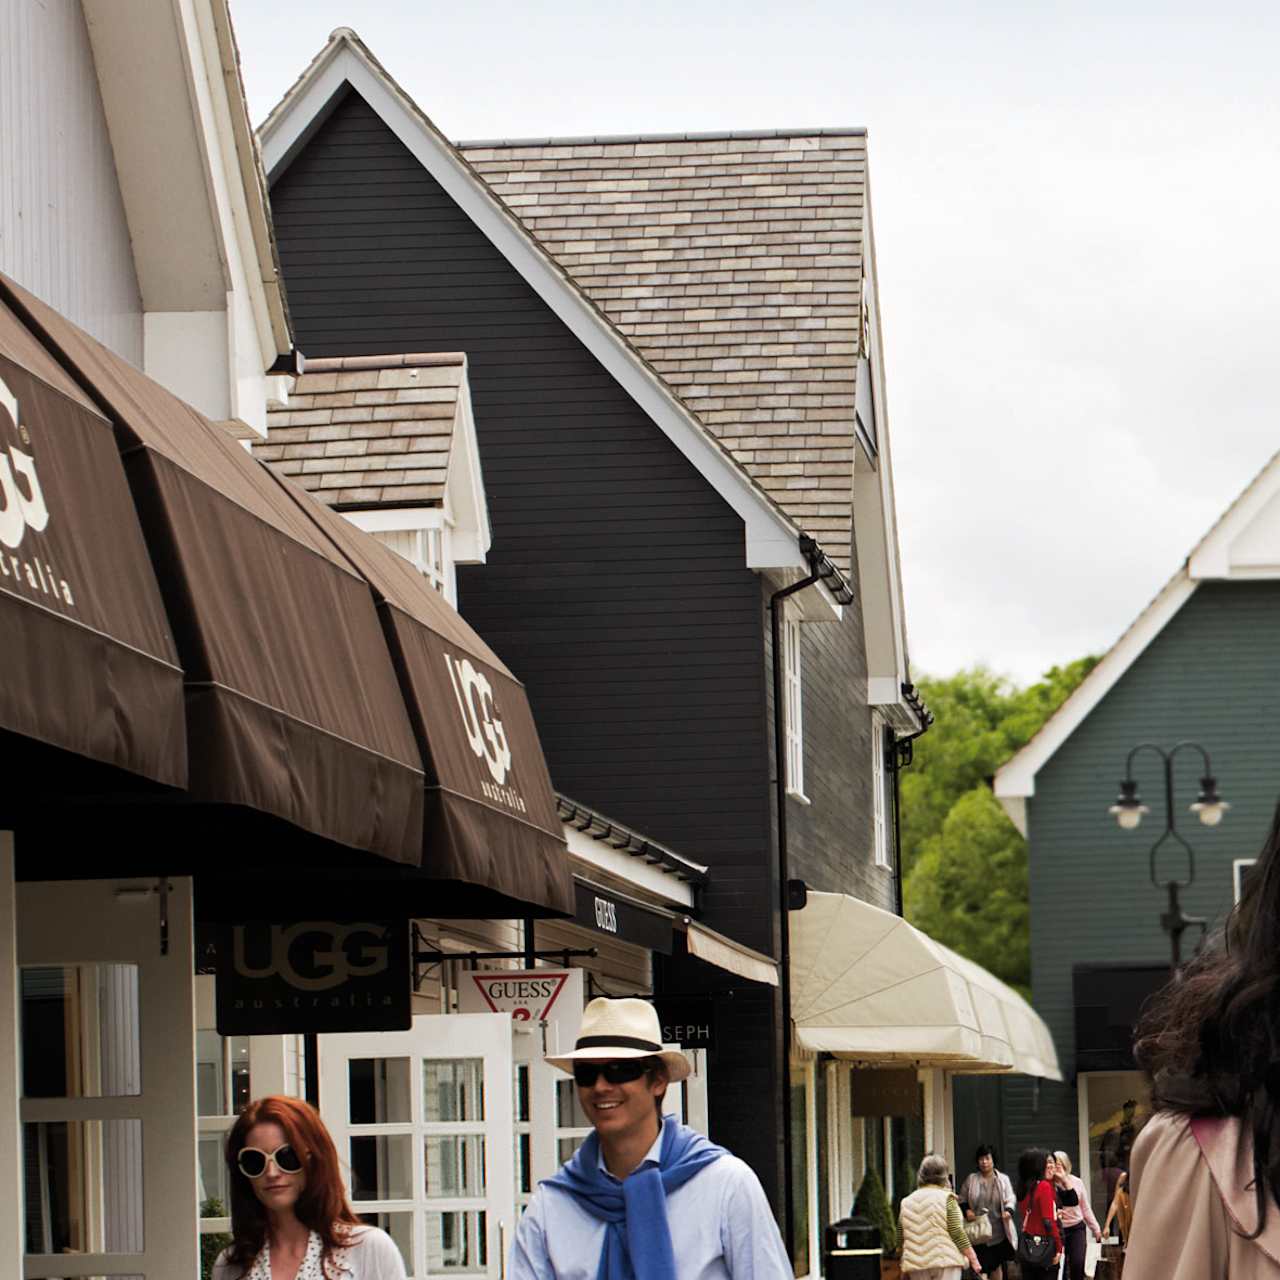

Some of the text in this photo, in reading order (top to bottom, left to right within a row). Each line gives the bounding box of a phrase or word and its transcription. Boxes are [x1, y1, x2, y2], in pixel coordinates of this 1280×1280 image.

[443, 653, 512, 786] UGG
[594, 896, 617, 934] GUESS
[232, 920, 390, 992] UGG
[233, 993, 393, 1009] australia
[488, 981, 552, 999] GUESS
[662, 1024, 710, 1041] SEPH
